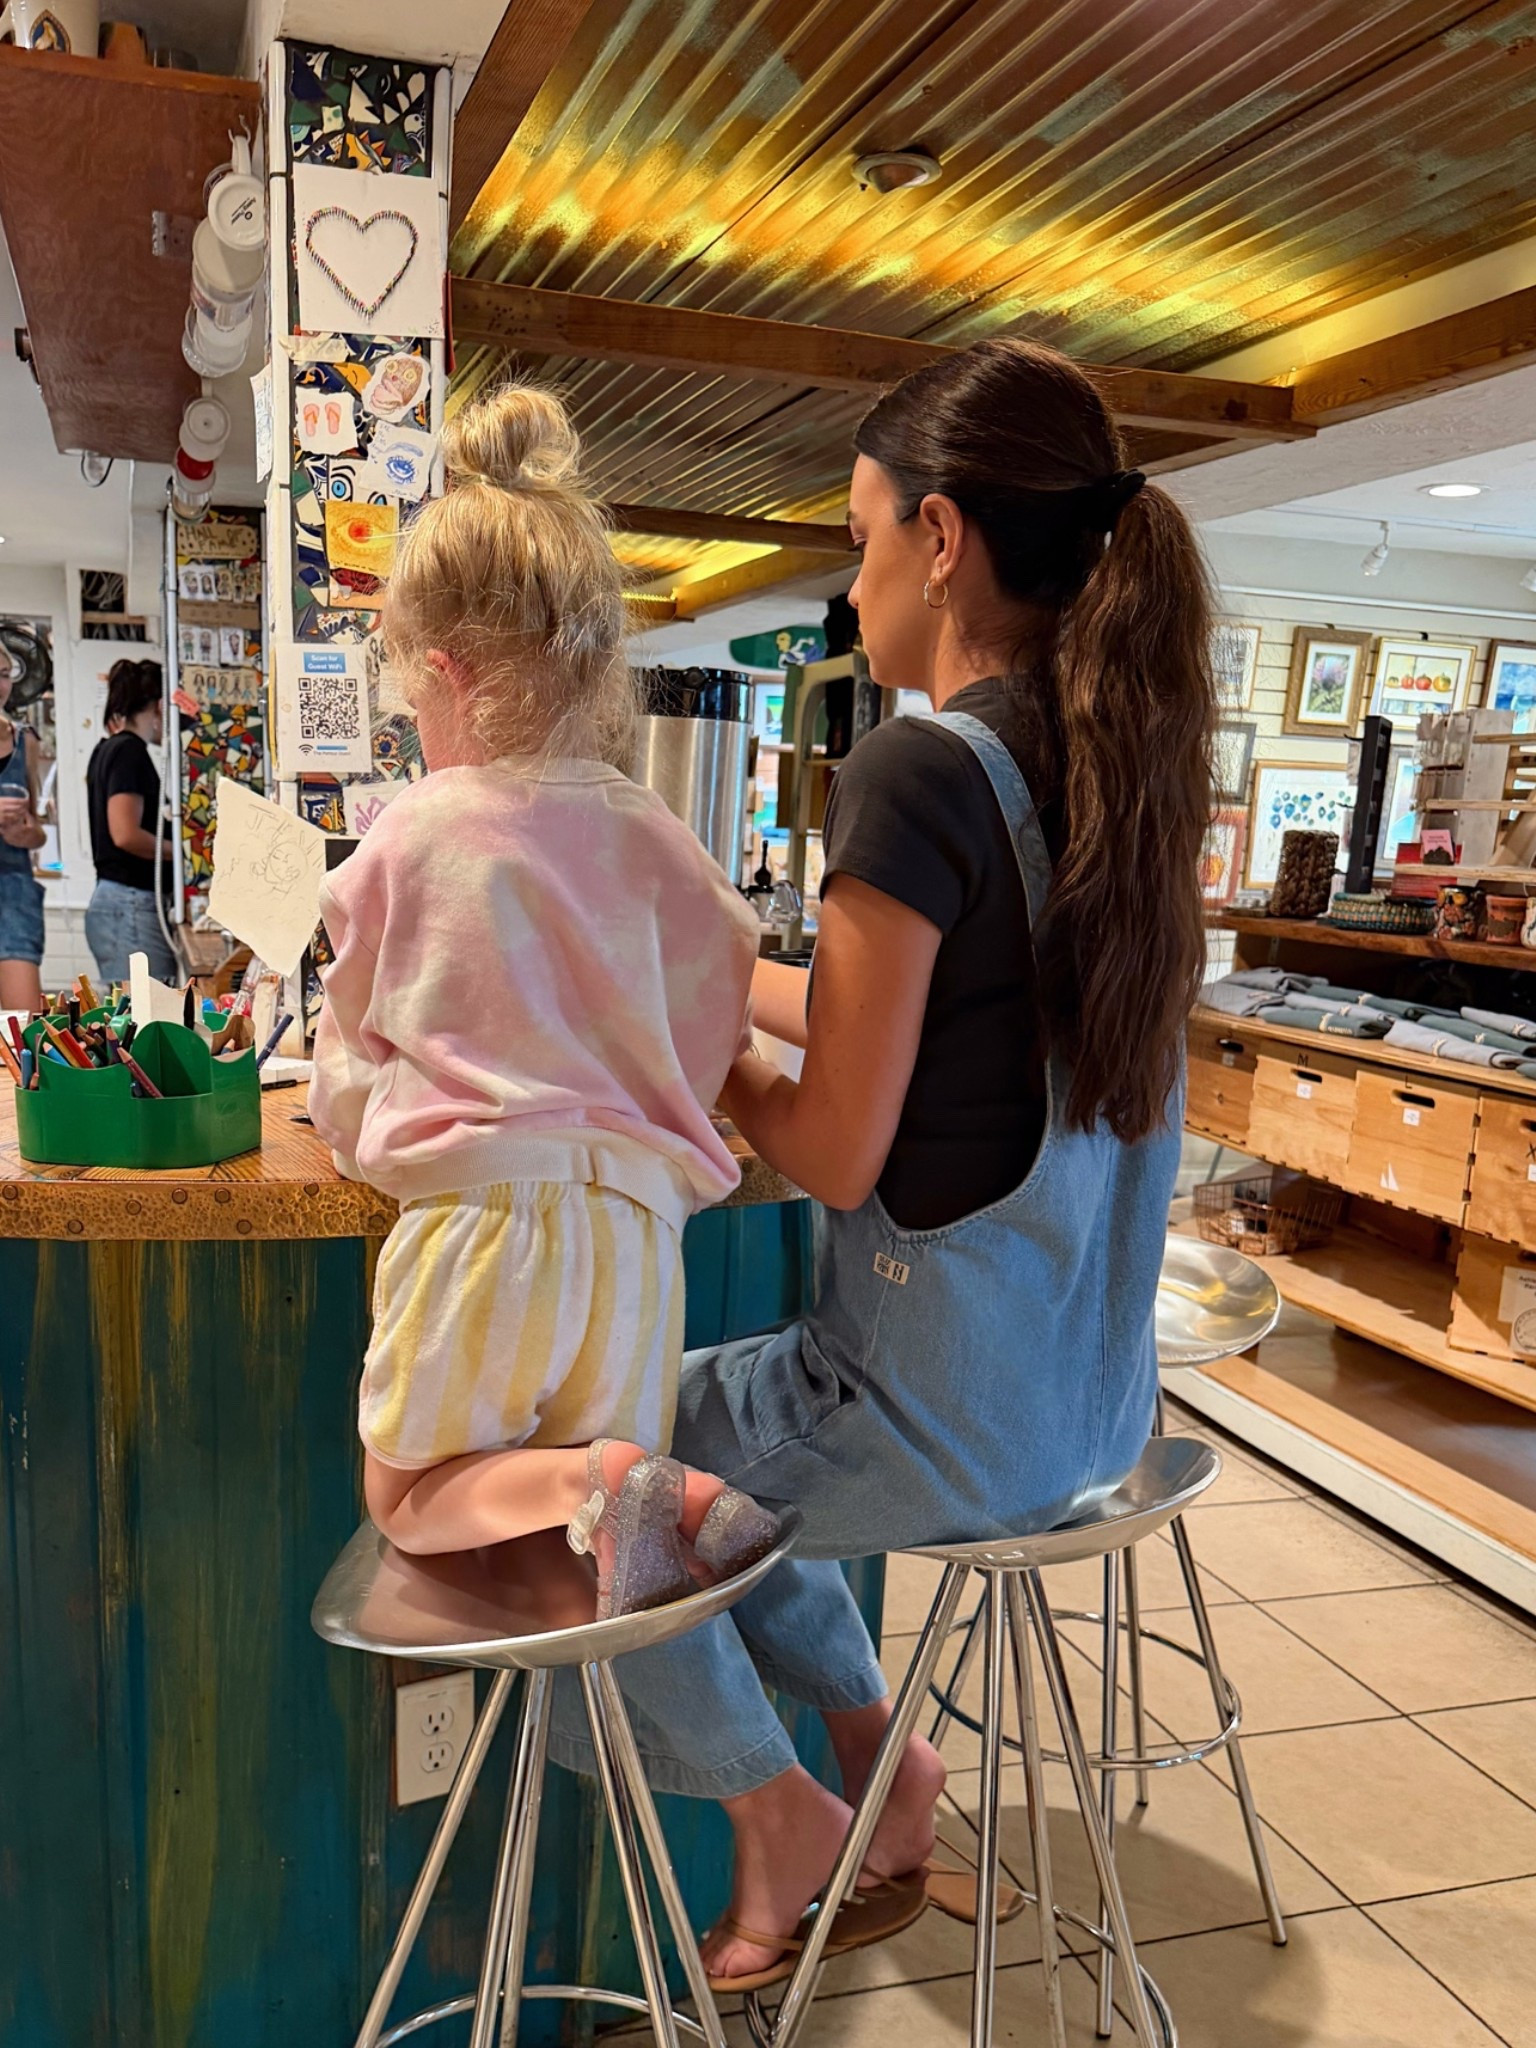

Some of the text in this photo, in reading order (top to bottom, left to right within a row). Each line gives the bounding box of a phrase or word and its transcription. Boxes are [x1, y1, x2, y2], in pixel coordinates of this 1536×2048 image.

[184, 525, 217, 540] HALL
[311, 654, 328, 662] Scan
[308, 662, 327, 670] Guest
[1297, 1052, 1309, 1068] M
